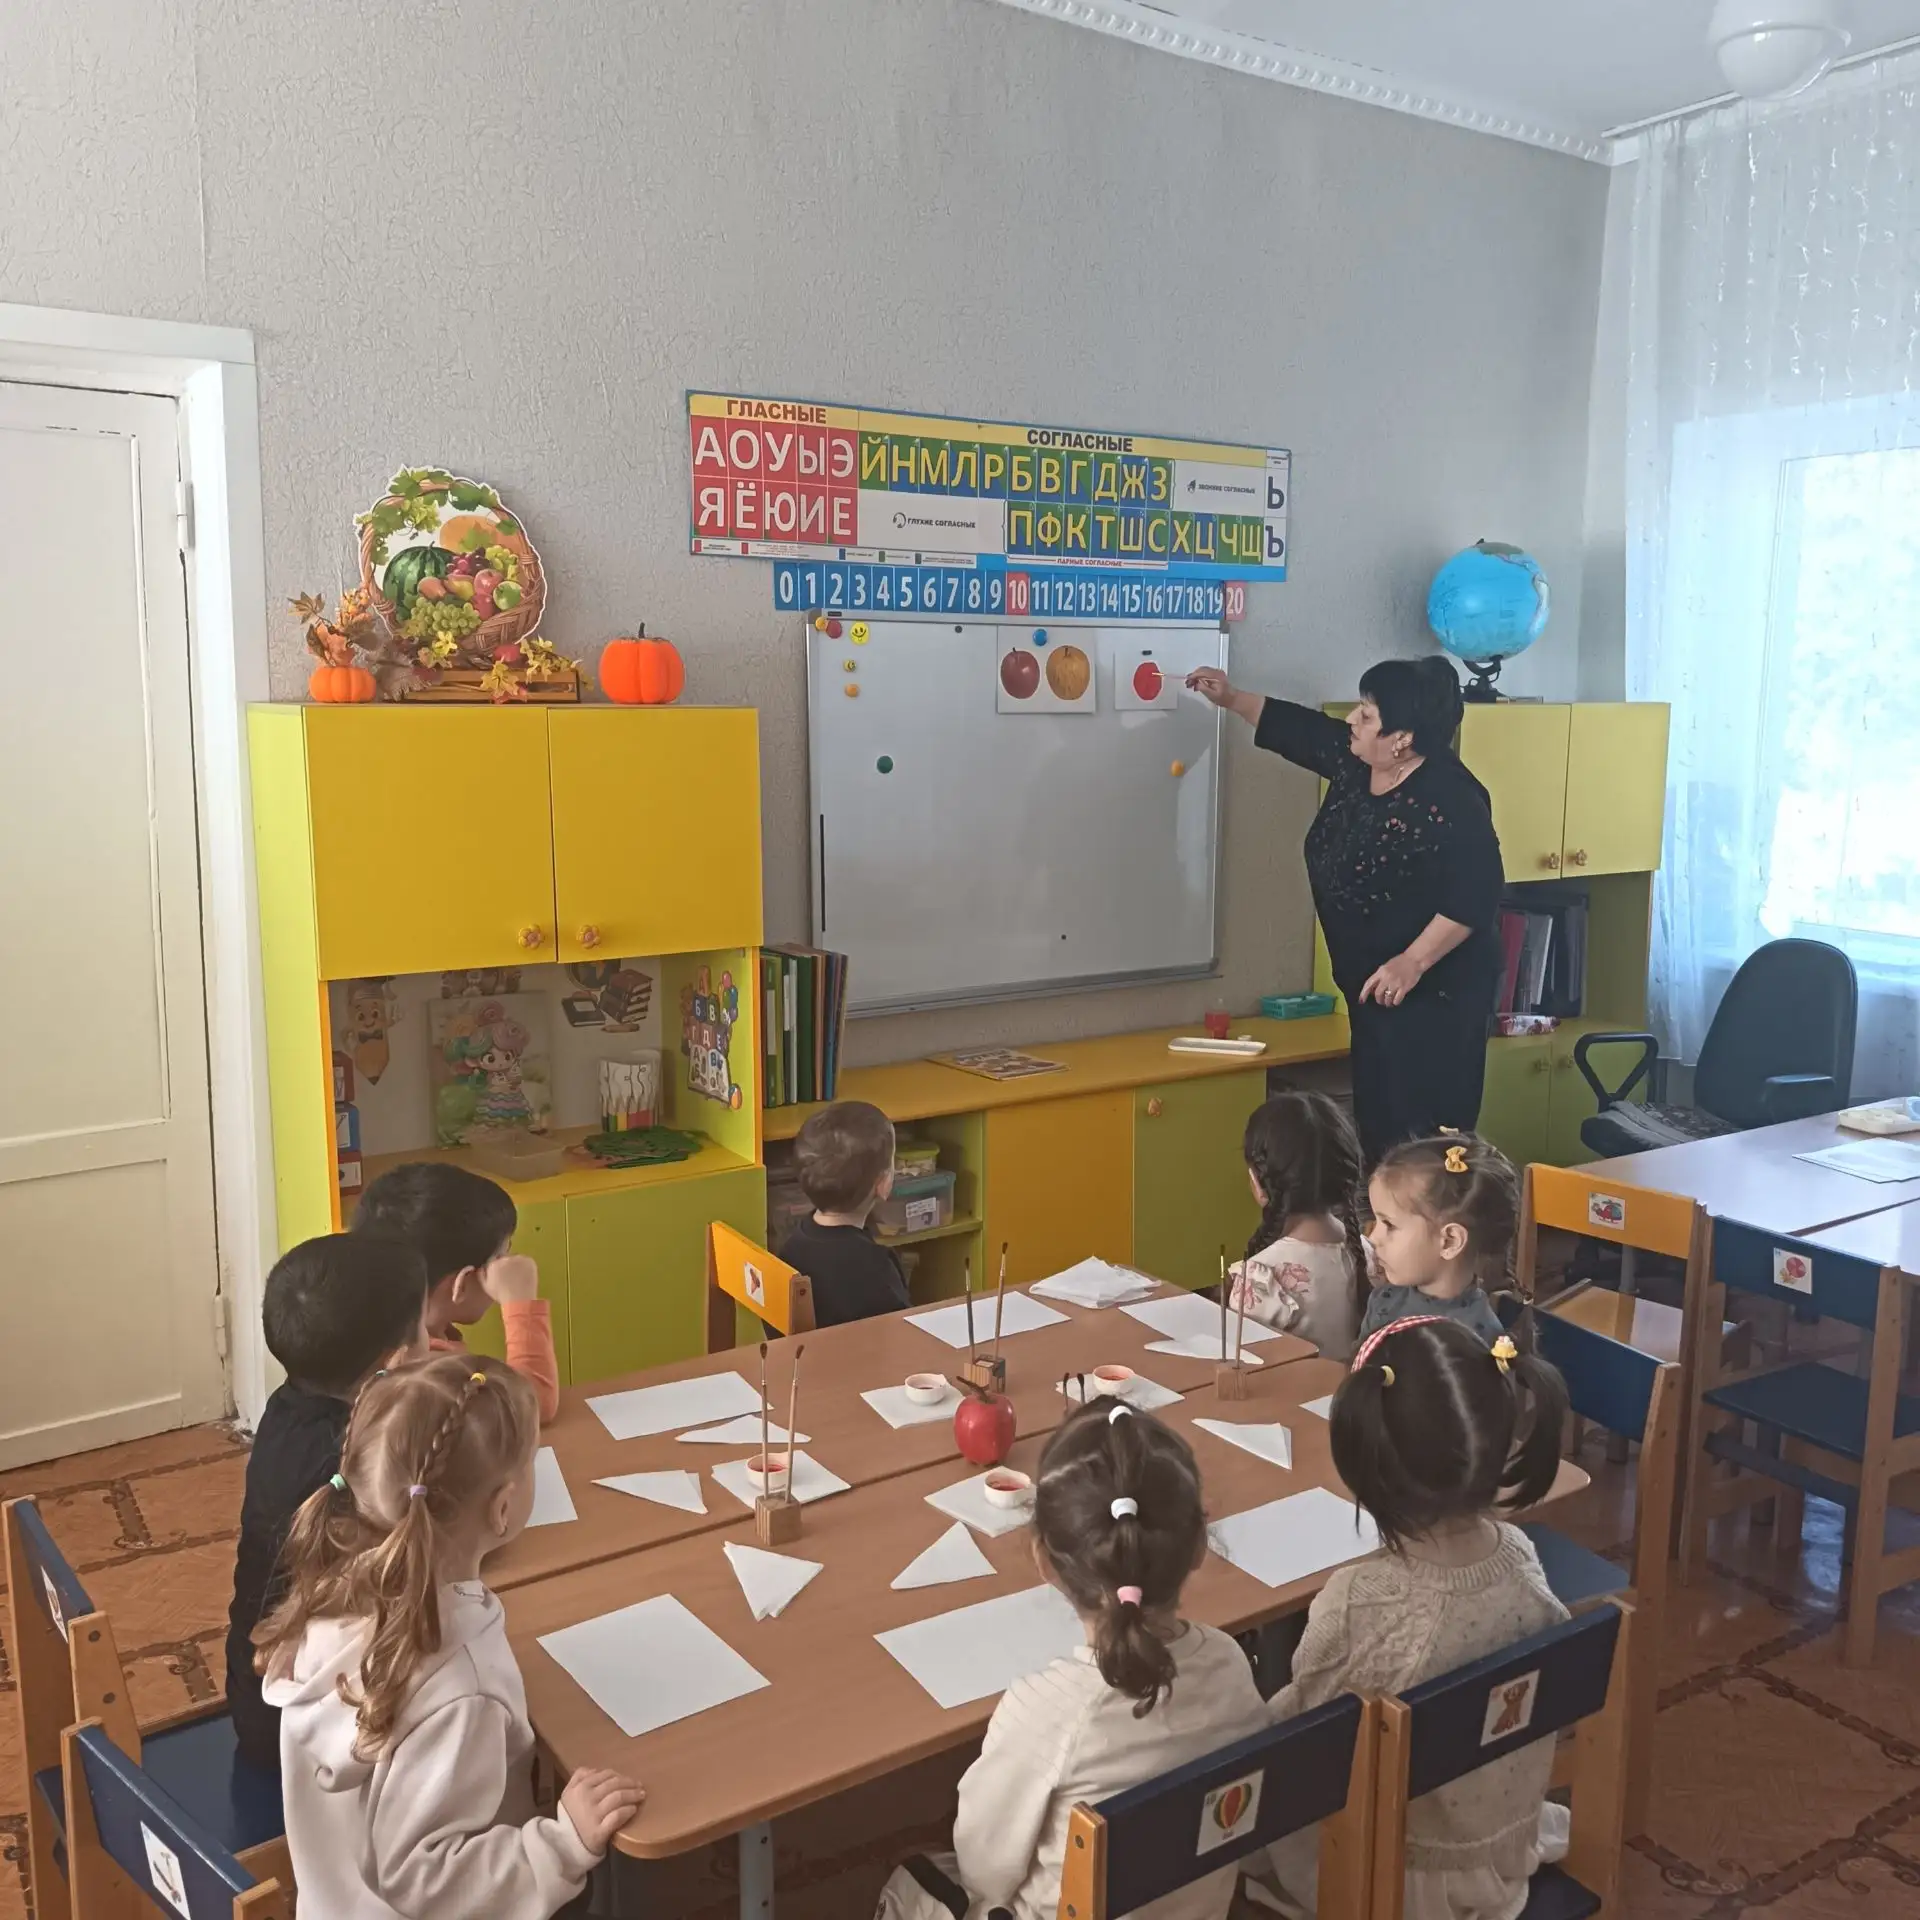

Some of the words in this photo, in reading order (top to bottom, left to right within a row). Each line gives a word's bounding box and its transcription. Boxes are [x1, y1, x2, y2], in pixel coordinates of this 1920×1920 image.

[727, 400, 827, 424] ГЛАСНЫЕ
[1027, 429, 1133, 452] СОГЛАСНЫЕ
[1267, 476, 1284, 509] Ь
[935, 520, 976, 528] СОГЛАСНЫЕ
[1265, 525, 1284, 558] Ъ
[1057, 557, 1084, 566] ПАРНЫЕ
[1085, 558, 1123, 567] СОГЛАСНЫЕ
[780, 571, 793, 603] 0
[805, 572, 816, 604] 1
[830, 573, 843, 605] 2
[854, 573, 866, 606] 3
[876, 575, 890, 607] 4
[900, 576, 913, 608] 5
[923, 577, 937, 608] 6
[947, 577, 959, 608] 7
[968, 578, 981, 608] 8
[990, 579, 1002, 609] 9
[1008, 579, 1027, 610] 10
[1031, 580, 1049, 610] 11
[1055, 581, 1074, 611] 12
[1079, 582, 1096, 612] 13
[1100, 583, 1118, 612] 14
[1122, 584, 1141, 613] 15
[1145, 584, 1163, 613] 16
[1166, 585, 1184, 614] 17
[1186, 586, 1204, 614] 18
[1207, 586, 1224, 614] 19
[1226, 587, 1244, 615] 20
[709, 1004, 716, 1022] В
